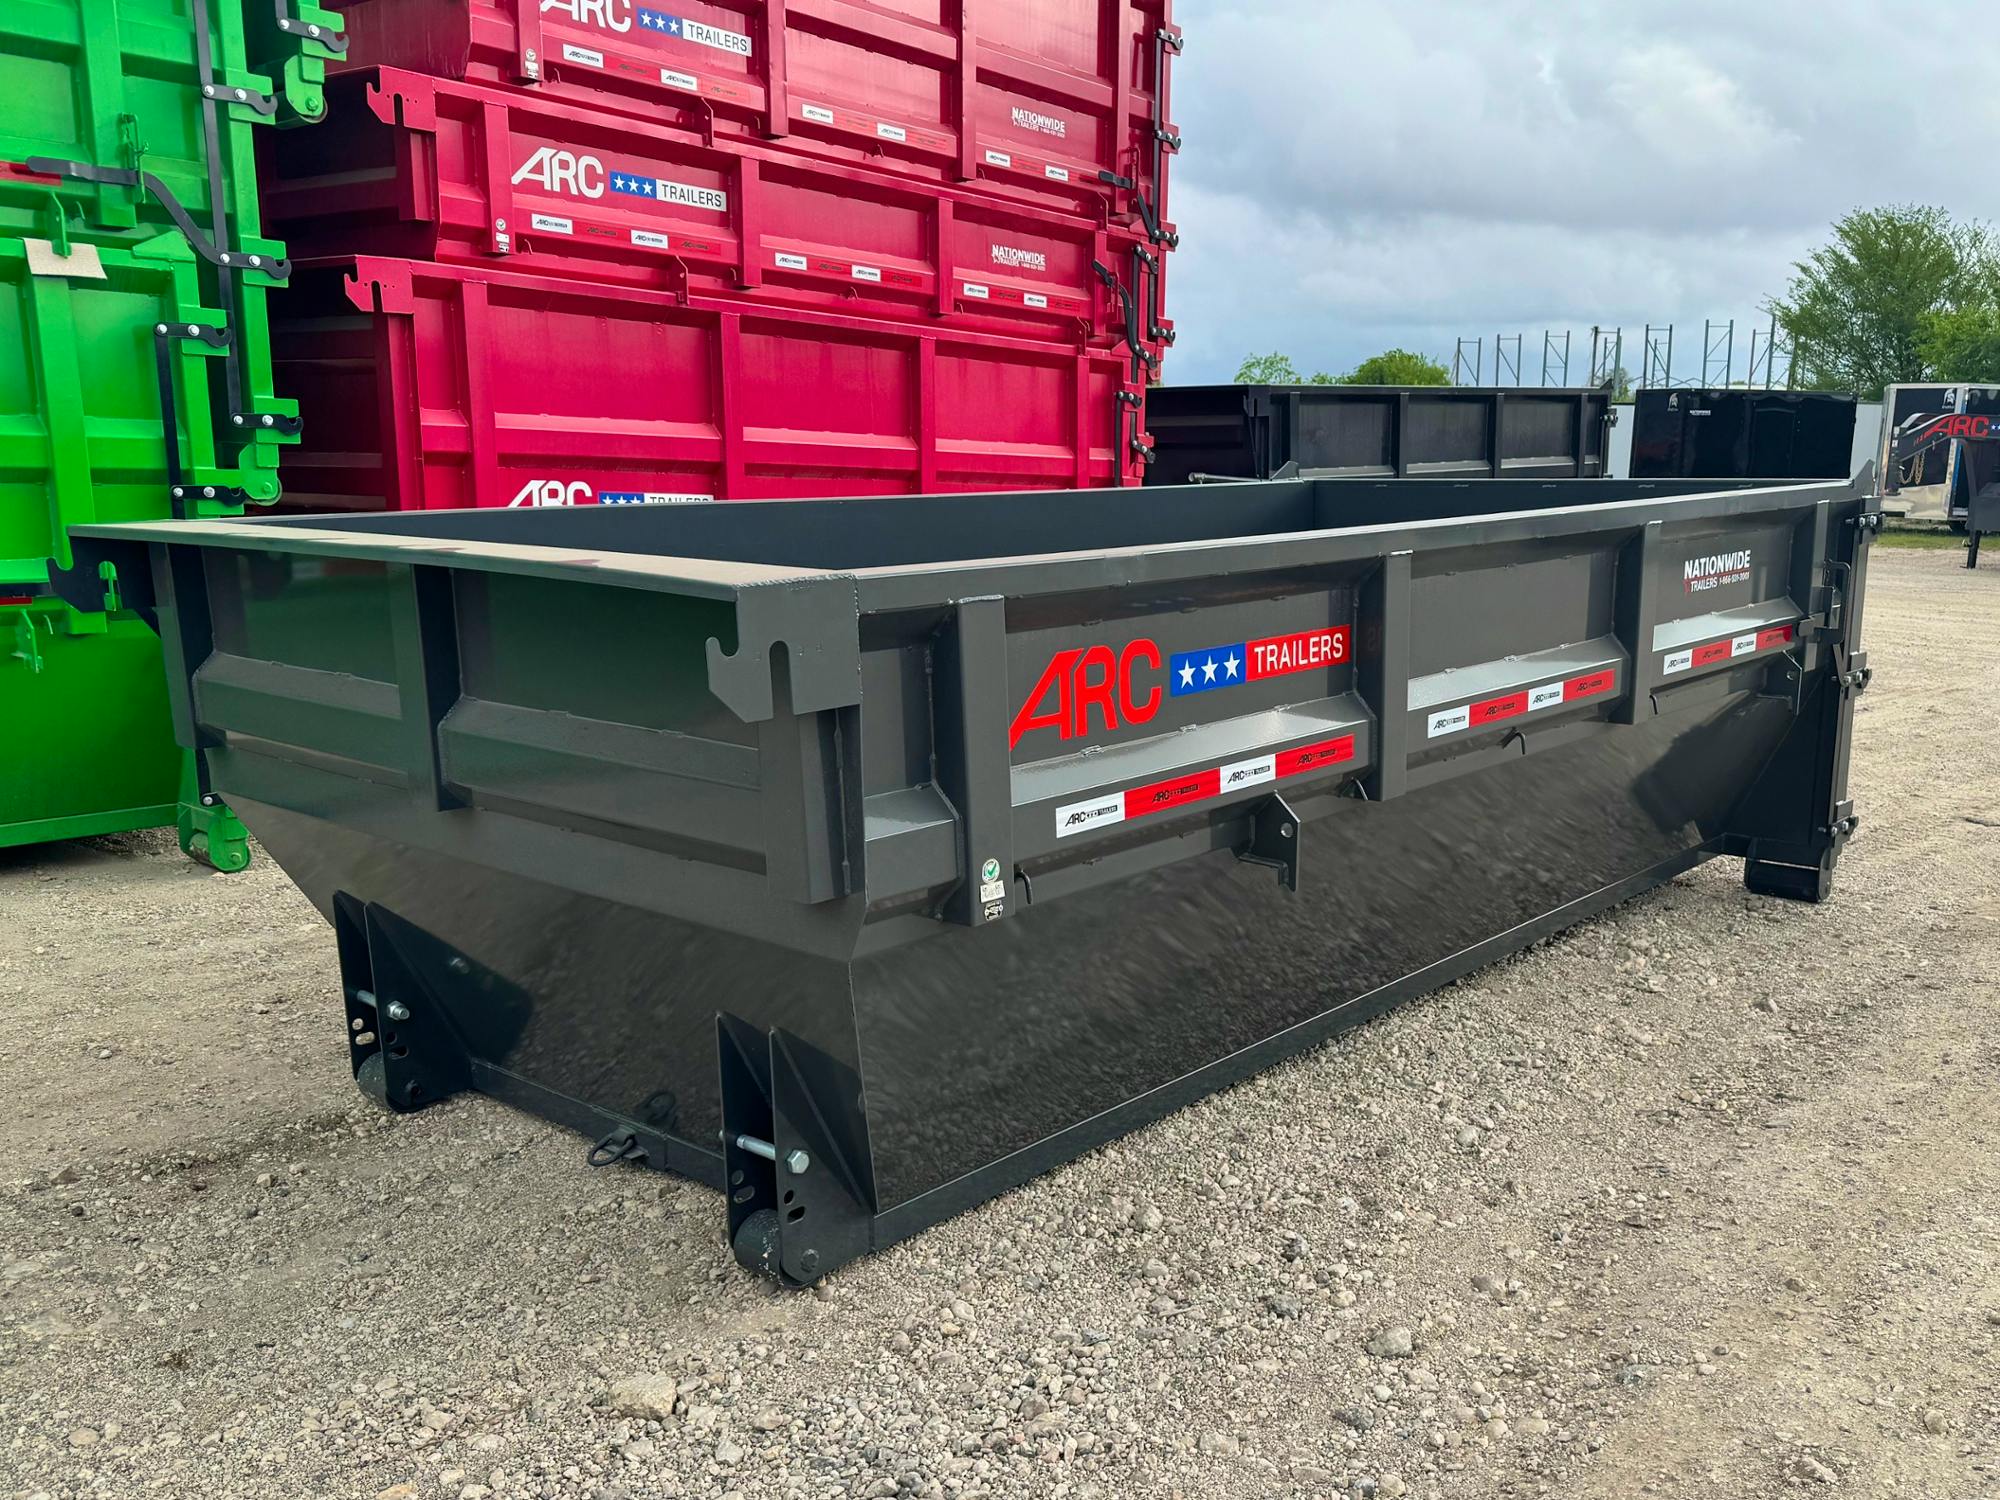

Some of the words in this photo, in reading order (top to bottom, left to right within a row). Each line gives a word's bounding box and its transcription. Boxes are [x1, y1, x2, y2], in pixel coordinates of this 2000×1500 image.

[688, 23, 747, 52] TRAILERS
[1012, 106, 1065, 133] NATIONWIDE
[511, 146, 604, 199] ARC
[662, 183, 722, 208] TRAILERS
[992, 244, 1046, 266] NATIONWIDE
[1923, 415, 1989, 438] ARC
[1684, 549, 1751, 579] NATIONWIDE
[1691, 577, 1718, 592] TRAILERS
[1009, 638, 1162, 752] ARC
[1254, 633, 1343, 673] TRAILERS
[1433, 719, 1447, 730] ARC
[1228, 770, 1244, 783] ARC
[1065, 811, 1086, 827] ARC
